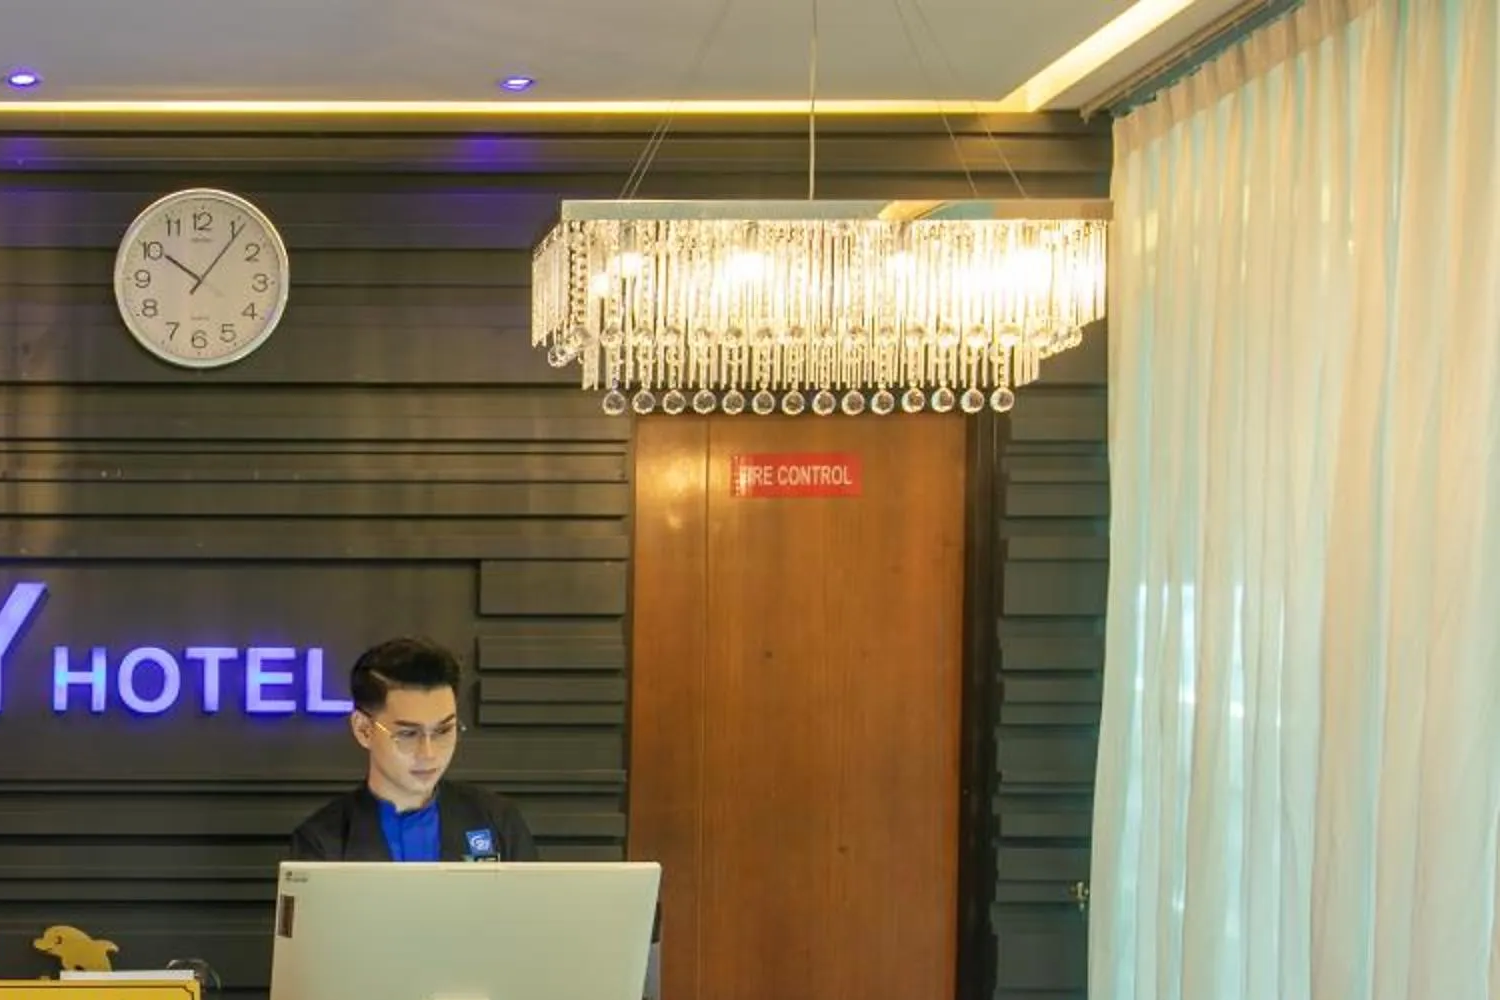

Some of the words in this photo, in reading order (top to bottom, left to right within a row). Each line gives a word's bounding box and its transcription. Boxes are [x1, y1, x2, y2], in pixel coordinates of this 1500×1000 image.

[166, 216, 181, 236] 11
[192, 211, 213, 231] 12
[143, 241, 163, 260] 10
[245, 243, 261, 262] 2
[135, 269, 151, 288] 9
[252, 273, 269, 292] 3
[141, 299, 158, 318] 8
[242, 302, 257, 320] 4
[166, 322, 181, 341] 7
[191, 330, 208, 349] 6
[220, 324, 236, 342] 5
[777, 464, 853, 486] CONTROL
[53, 646, 354, 714] HOTEL
